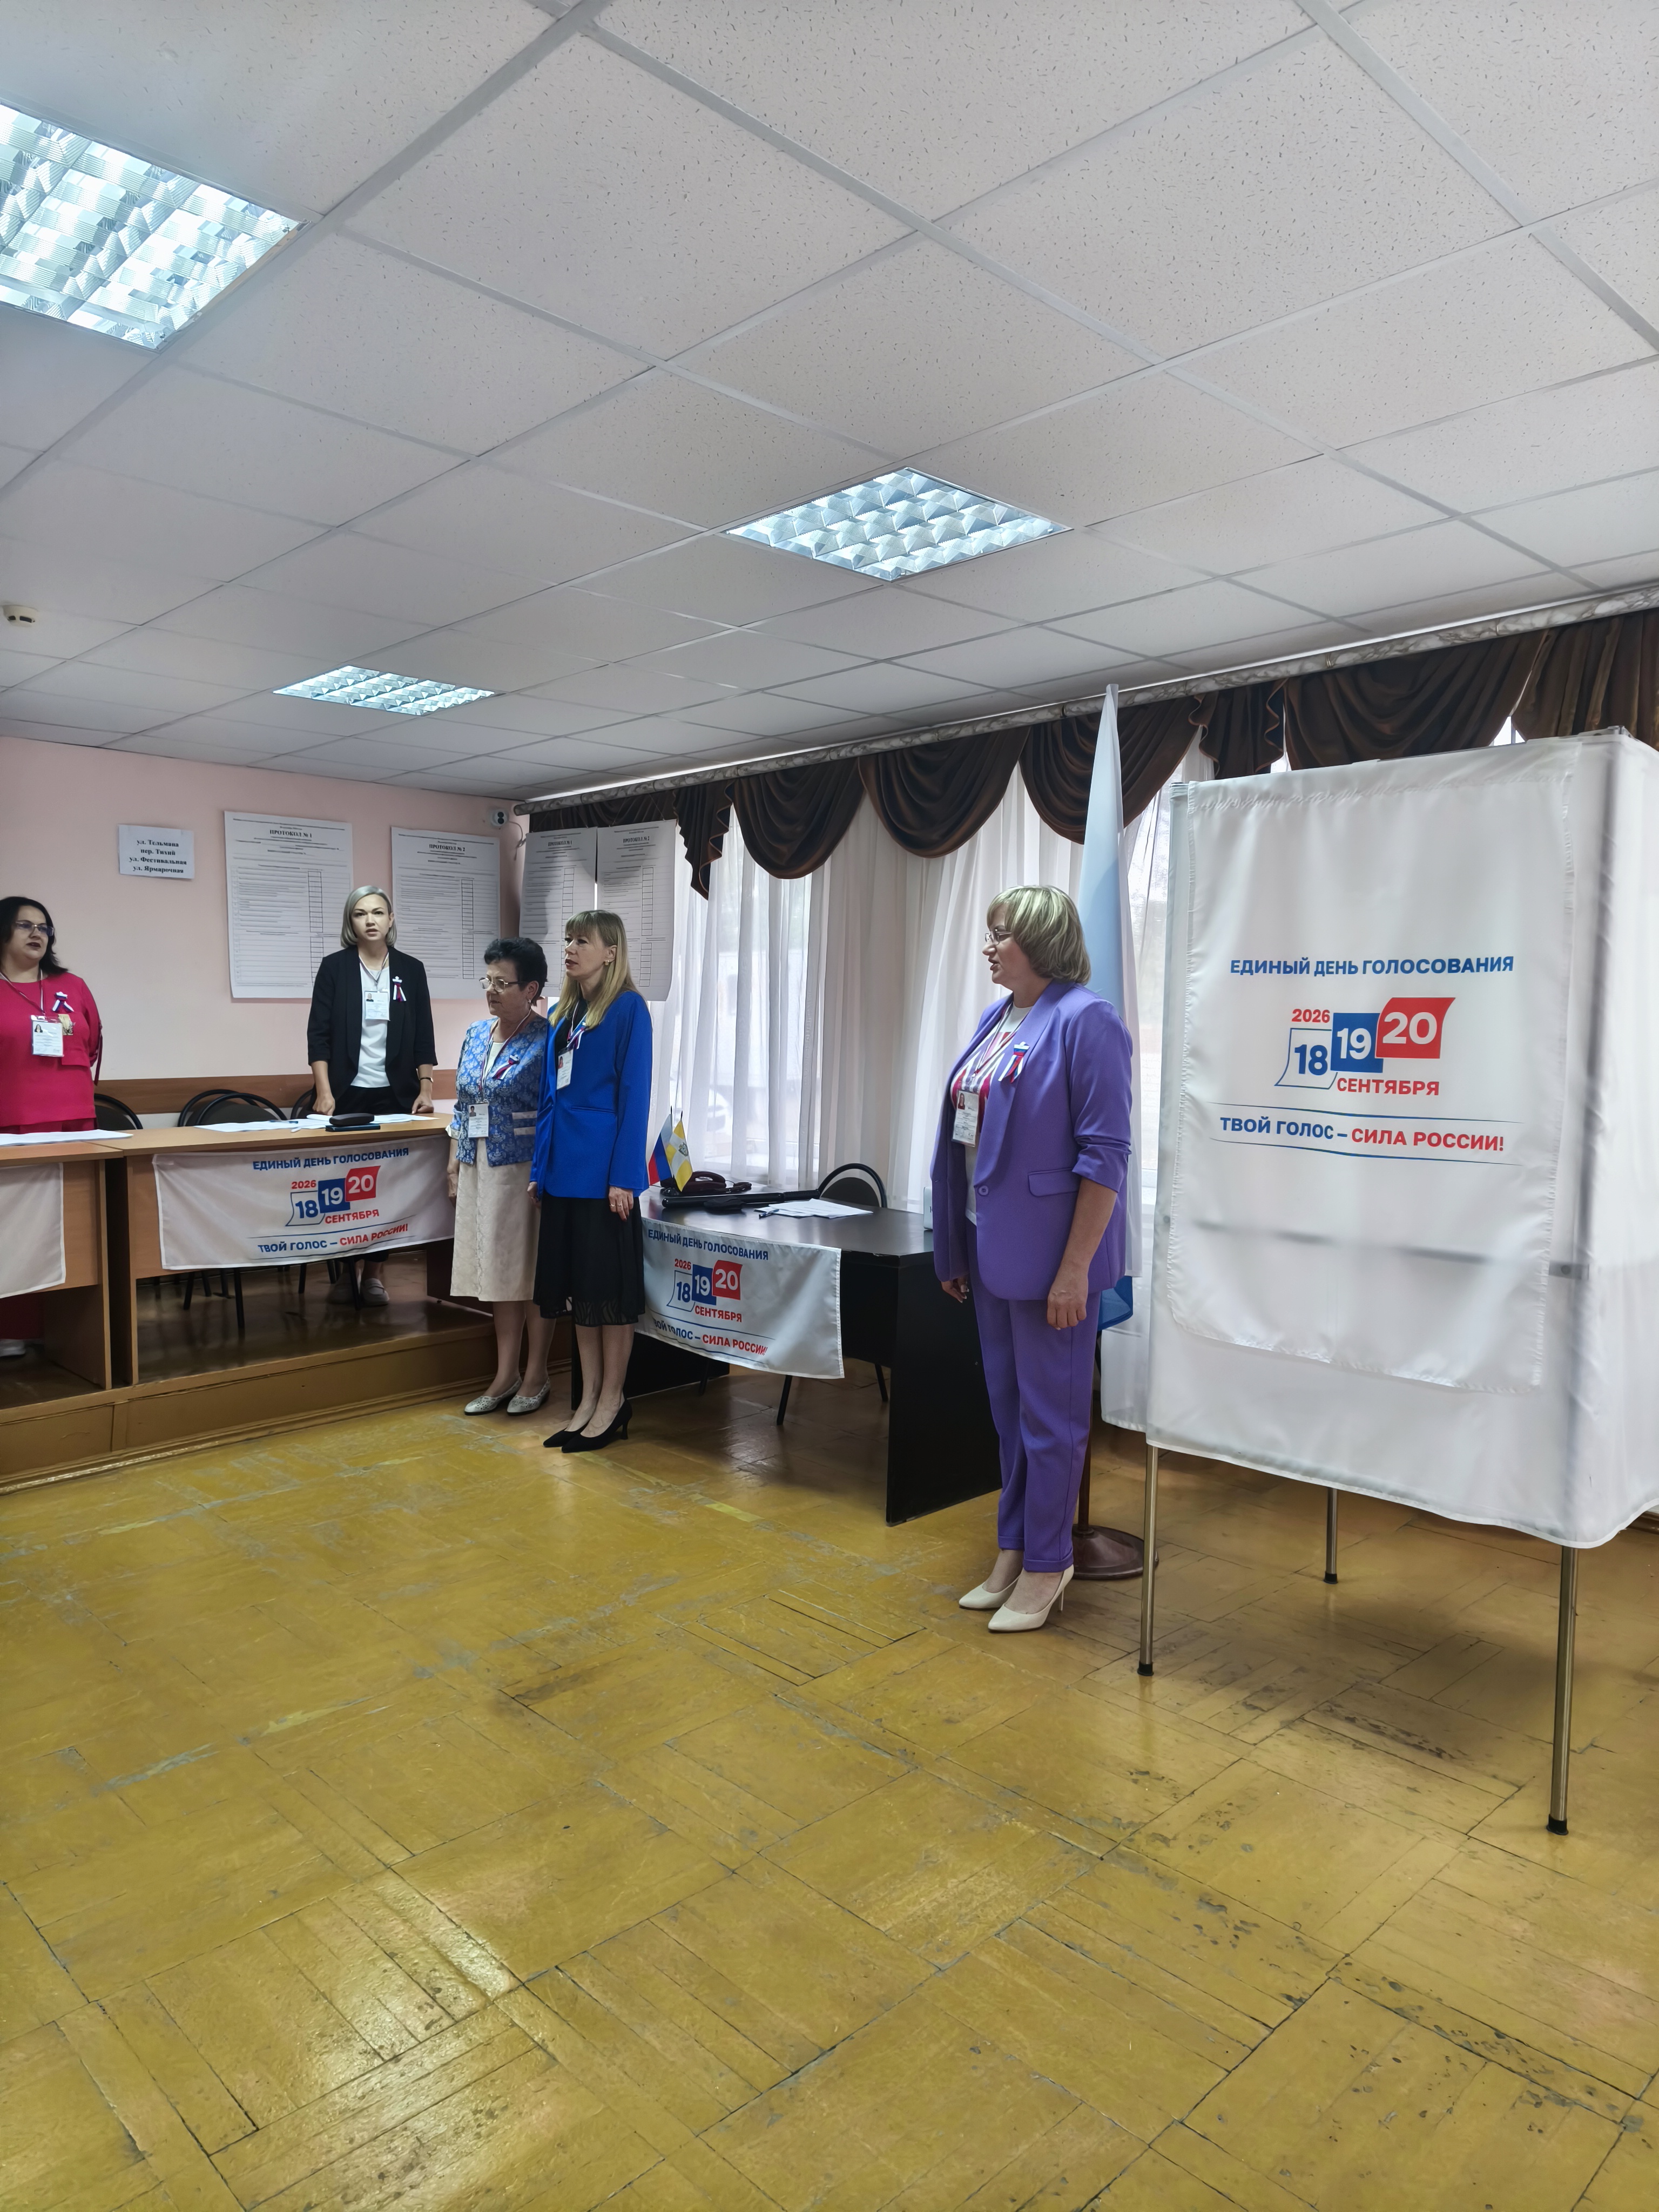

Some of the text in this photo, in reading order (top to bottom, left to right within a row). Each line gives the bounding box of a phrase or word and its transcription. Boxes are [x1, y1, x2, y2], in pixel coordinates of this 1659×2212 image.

[140, 857, 187, 865] Фестивальная
[1230, 956, 1514, 976] ЕДИНЫЙ ДЕНЬ ГОЛОСОВАНИЯ
[1292, 1009, 1331, 1023] 2026
[1294, 1012, 1437, 1076] 18 19 20
[1337, 1078, 1439, 1096] СЕНТЯБРЯ
[1220, 1117, 1271, 1134] ТВОЙ
[1276, 1121, 1334, 1139] ГОЛОС
[1351, 1128, 1407, 1146] СИЛА
[1413, 1132, 1504, 1151] РОССИИ!
[253, 1148, 409, 1171] ЕДИНЫЙ ДЕНЬ ГОЛОСОВАНИЯ
[292, 1179, 316, 1189] 2026
[295, 1175, 374, 1219] 18 19 20
[325, 1209, 379, 1224] СЕНТЯБРЯ
[258, 1241, 287, 1253] ТВОЙ
[290, 1240, 327, 1251] ГОЛОС
[340, 1233, 368, 1246] СИЛА
[372, 1223, 408, 1242] РОССИИ!
[648, 1229, 768, 1260] ЕДИНЫЙ ДЕНЬ ГОЛОСОВАНИЯ
[675, 1259, 691, 1270] 2026
[677, 1269, 738, 1303] 18 19 20
[695, 1305, 742, 1323] СЕНТЯБРЯ
[668, 1326, 693, 1340] ГОЛОС
[703, 1334, 730, 1347] СИЛА
